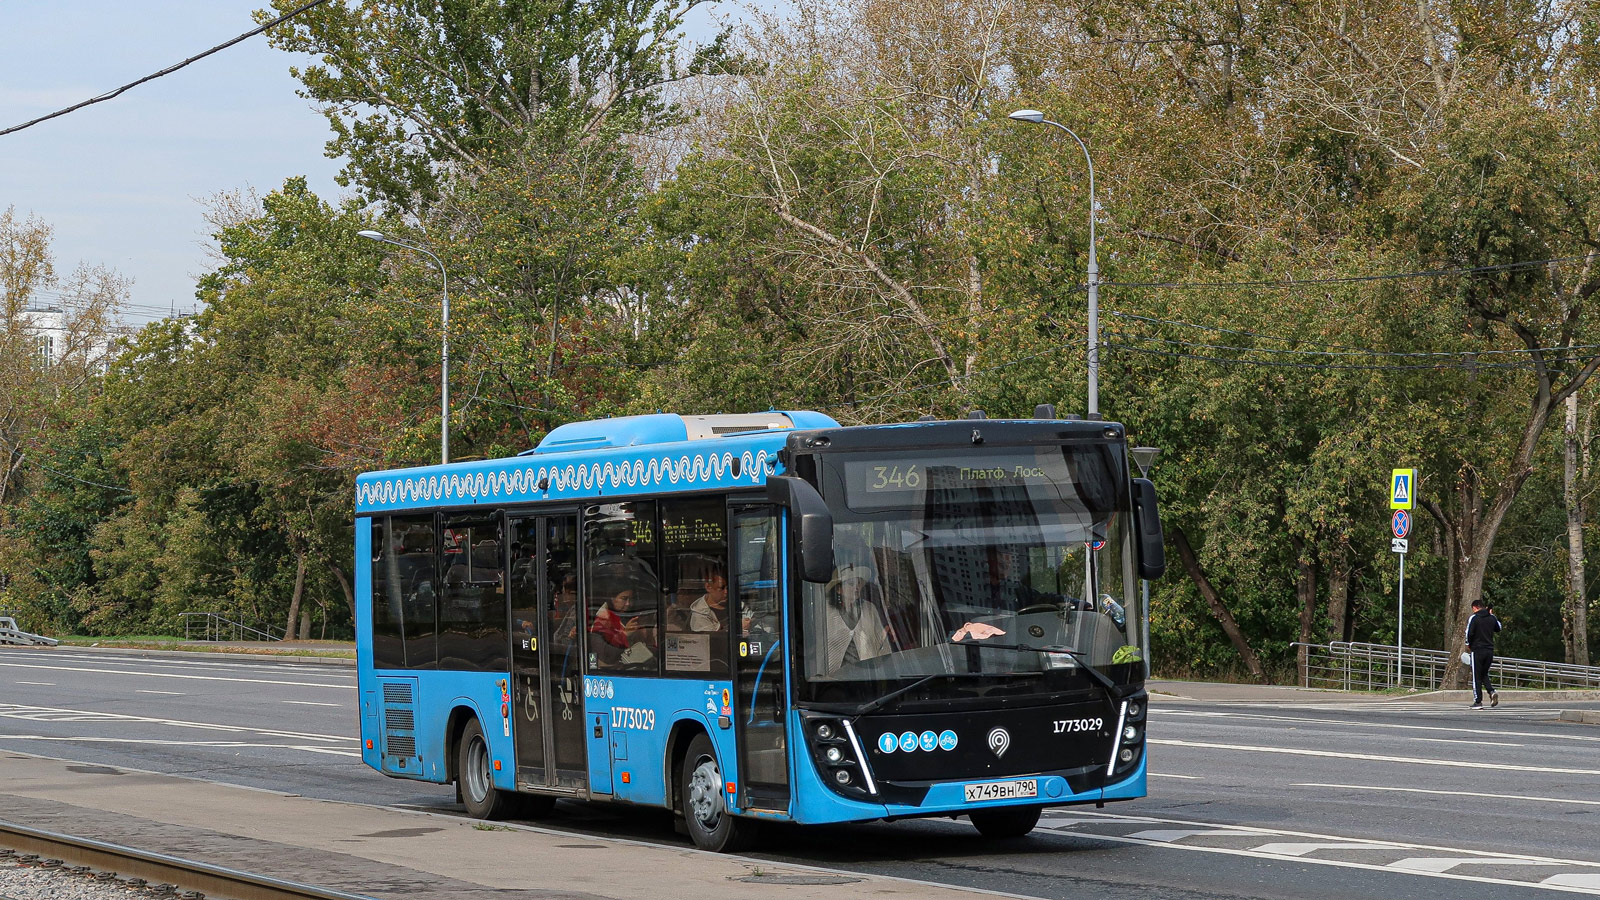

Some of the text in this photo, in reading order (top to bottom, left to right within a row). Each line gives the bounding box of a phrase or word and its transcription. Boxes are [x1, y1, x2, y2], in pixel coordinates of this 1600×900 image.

[872, 464, 1045, 489] 346 Платф. Лось
[631, 520, 652, 544] 346
[611, 706, 656, 731] 1773029
[1053, 717, 1103, 733] 1773029
[1016, 781, 1034, 792] 790
